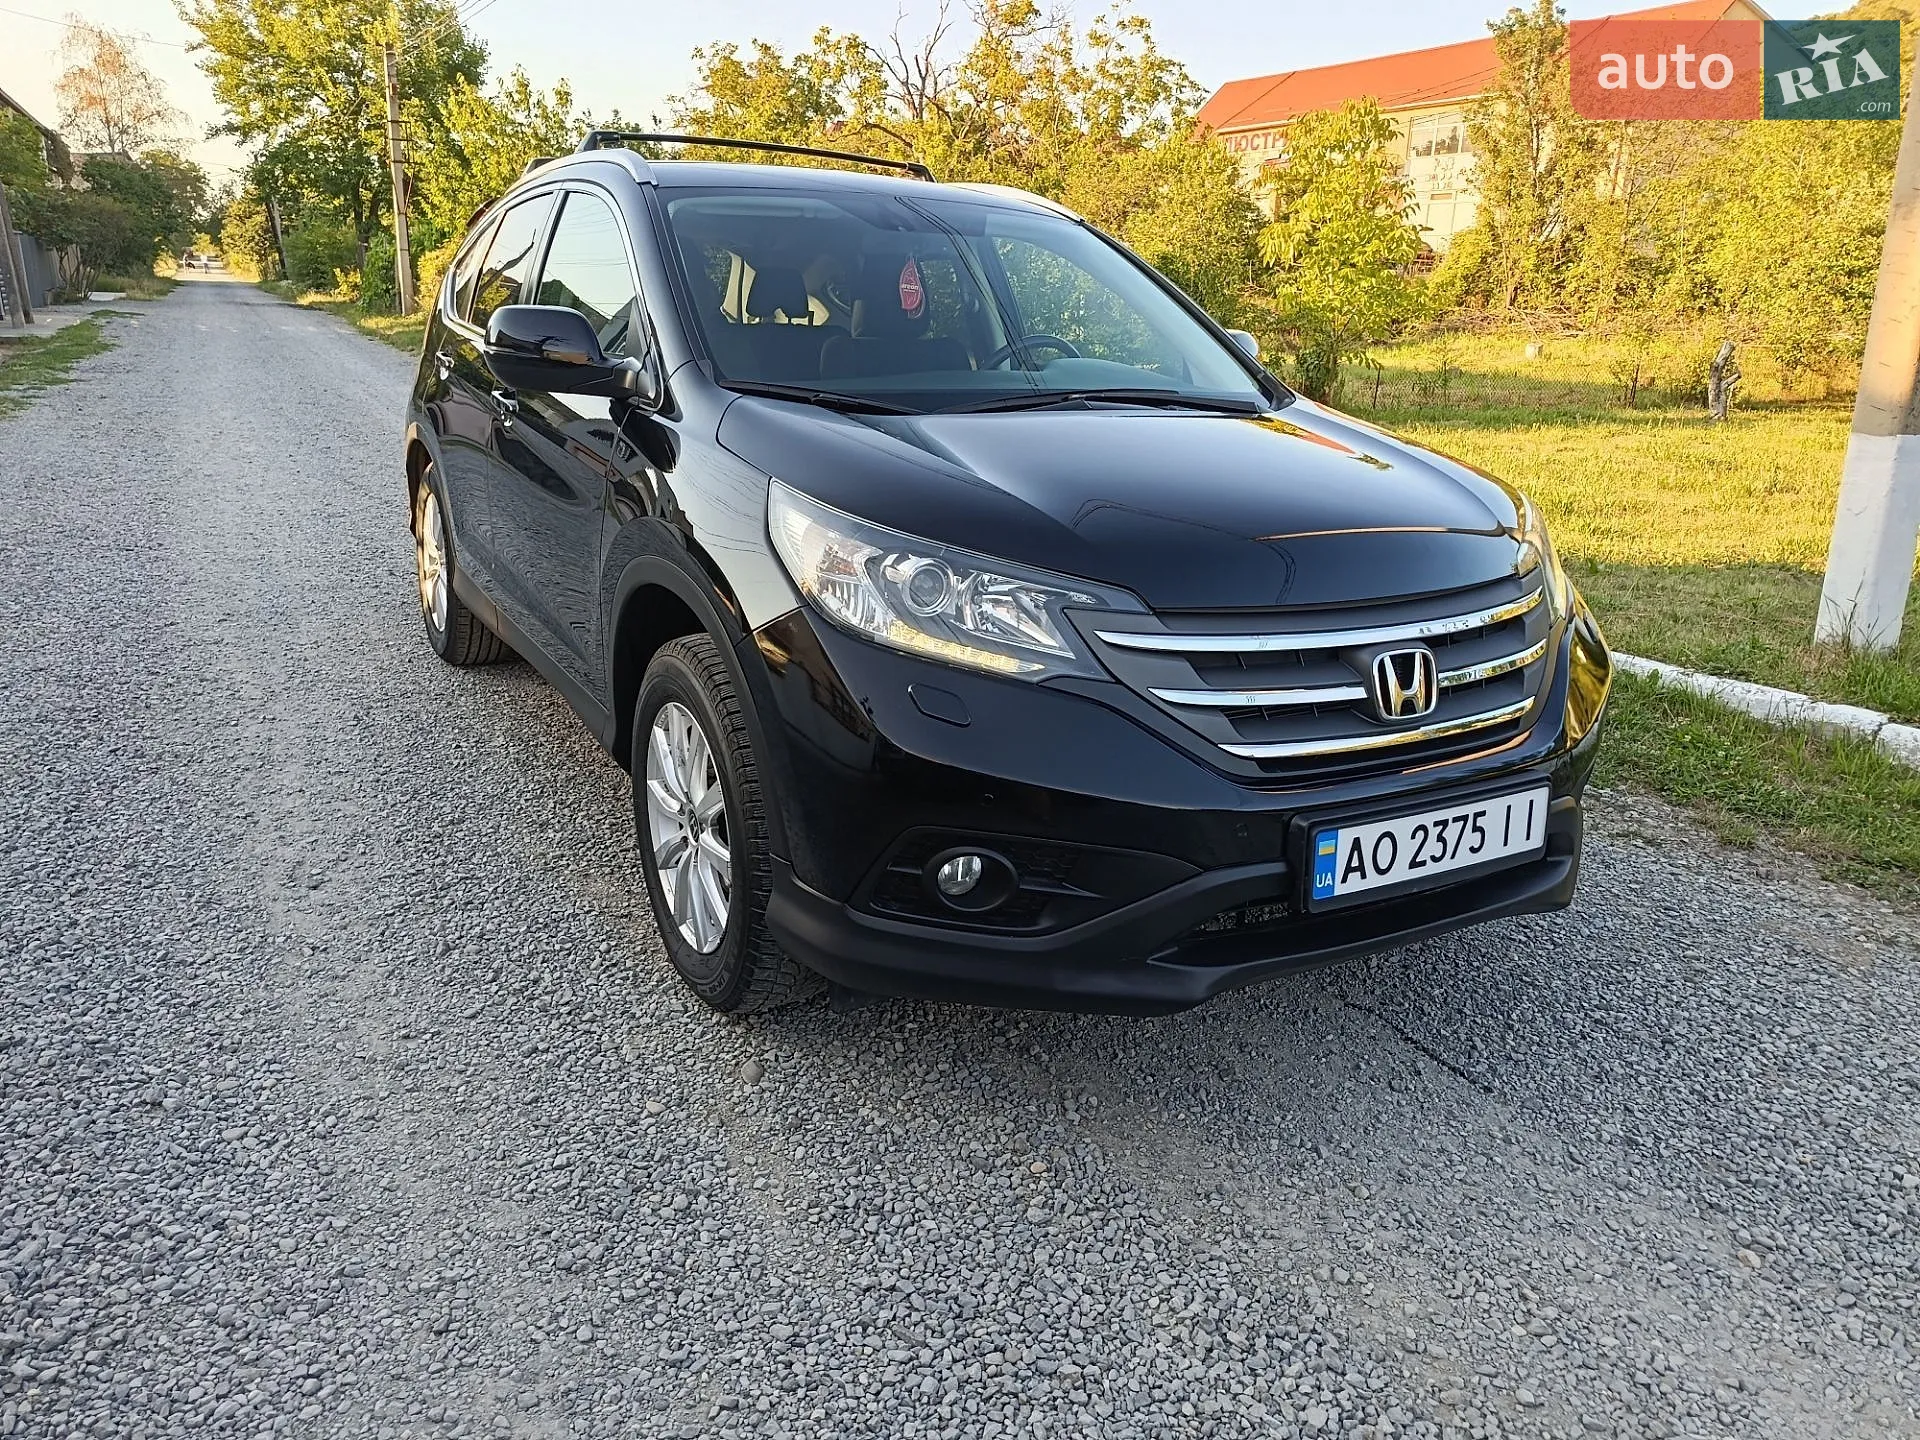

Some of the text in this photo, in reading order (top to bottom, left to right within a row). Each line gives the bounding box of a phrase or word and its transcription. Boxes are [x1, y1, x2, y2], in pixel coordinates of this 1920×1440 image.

[1340, 831, 1398, 884] AO
[1408, 810, 1487, 870] 2375
[1315, 872, 1333, 888] UA
